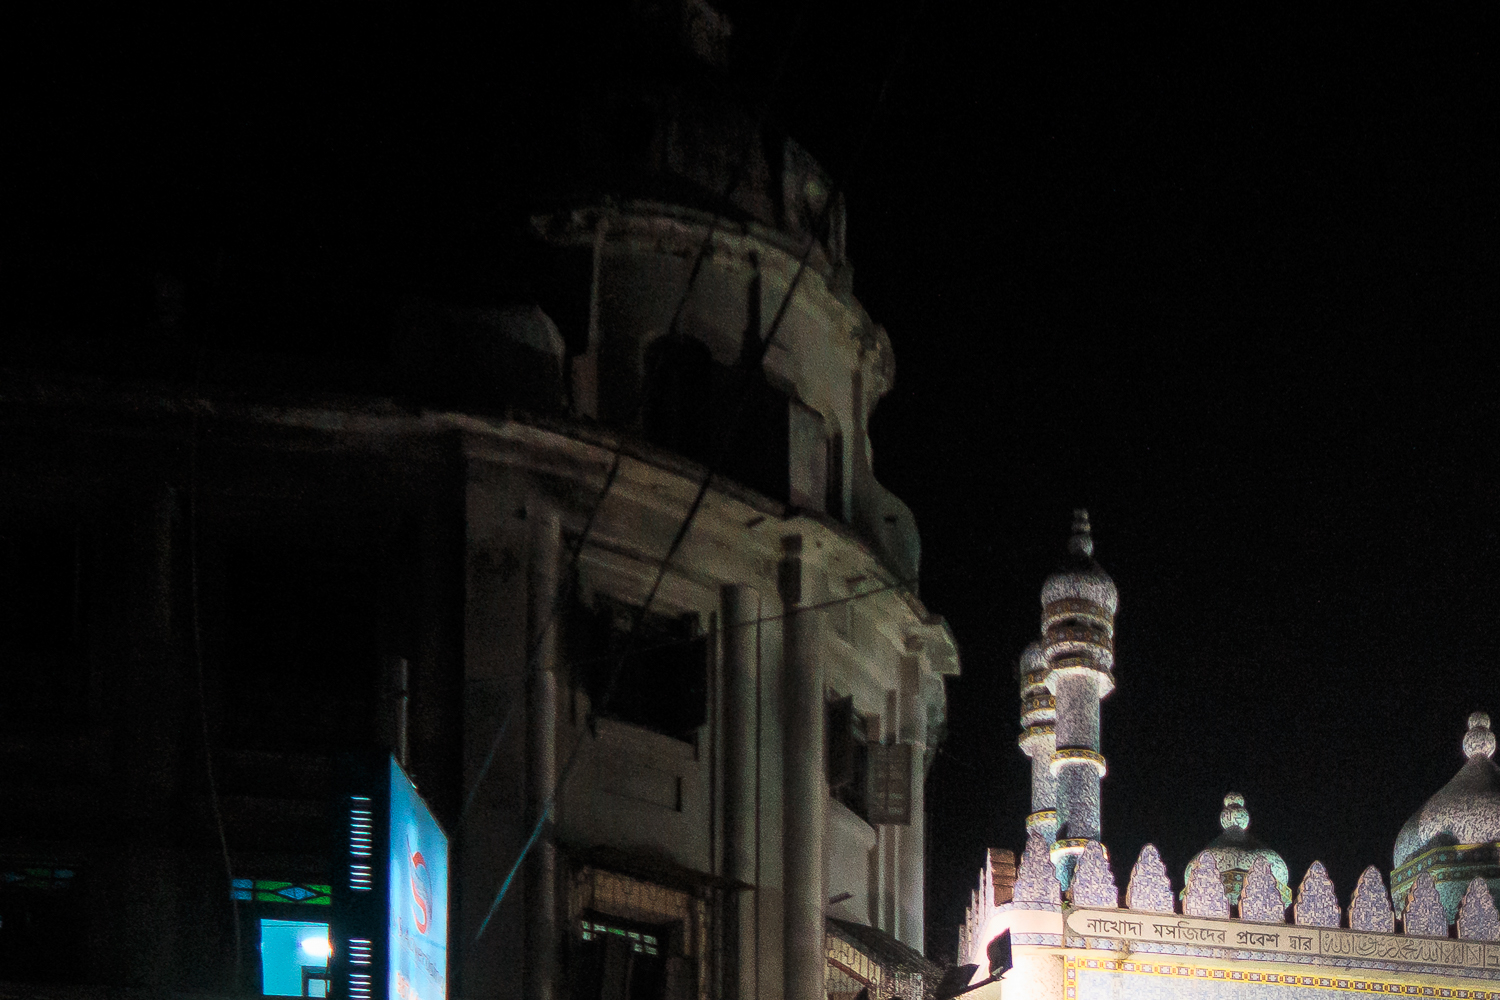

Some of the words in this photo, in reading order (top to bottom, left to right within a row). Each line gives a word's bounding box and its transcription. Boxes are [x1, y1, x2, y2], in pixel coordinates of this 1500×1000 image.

[1087, 918, 1143, 936] নাখোদা
[1153, 921, 1227, 943] মসজিদের
[1236, 931, 1280, 948] প্রবেশ
